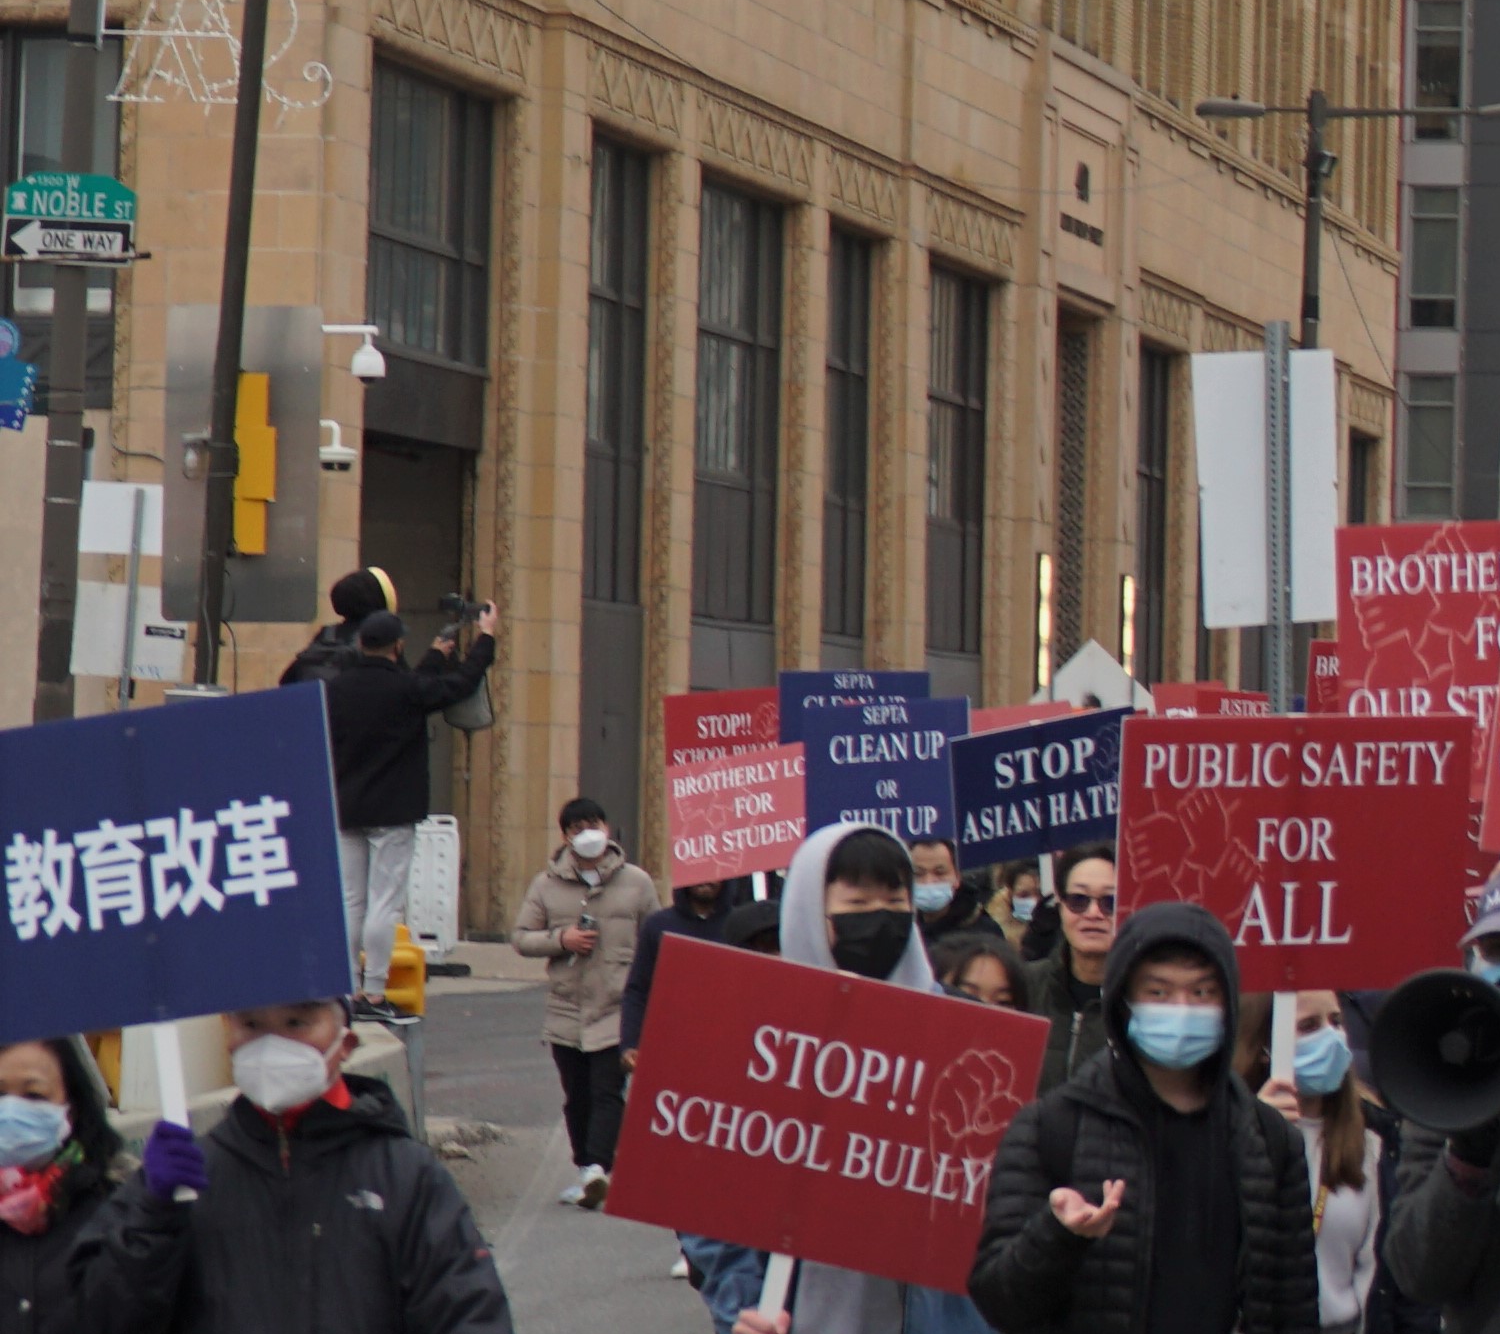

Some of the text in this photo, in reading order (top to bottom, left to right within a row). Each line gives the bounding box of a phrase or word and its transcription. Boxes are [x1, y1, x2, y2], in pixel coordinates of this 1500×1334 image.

[66, 174, 80, 189] W
[31, 189, 133, 219] NOBLE ST
[42, 232, 116, 252] ONE WAY
[834, 673, 875, 690] SEPTA
[697, 712, 752, 740] STOP!!
[863, 705, 909, 727] SEPTA
[829, 729, 946, 766] CLEAN UP
[994, 735, 1096, 790] STOP
[1143, 740, 1456, 789] PUBLIC SAFETY
[672, 762, 778, 800] BROTHERLY
[875, 779, 899, 800] OR
[733, 792, 775, 819] FOR
[906, 805, 940, 836] UP
[962, 798, 1042, 845] ASIAN
[673, 835, 718, 861] OUR
[1256, 816, 1336, 863] FOR
[4, 794, 298, 941] 教育改革
[1234, 880, 1353, 948] ALL
[747, 1023, 926, 1117] STOP!!
[651, 1088, 993, 1206] SCHOOL BULLY
